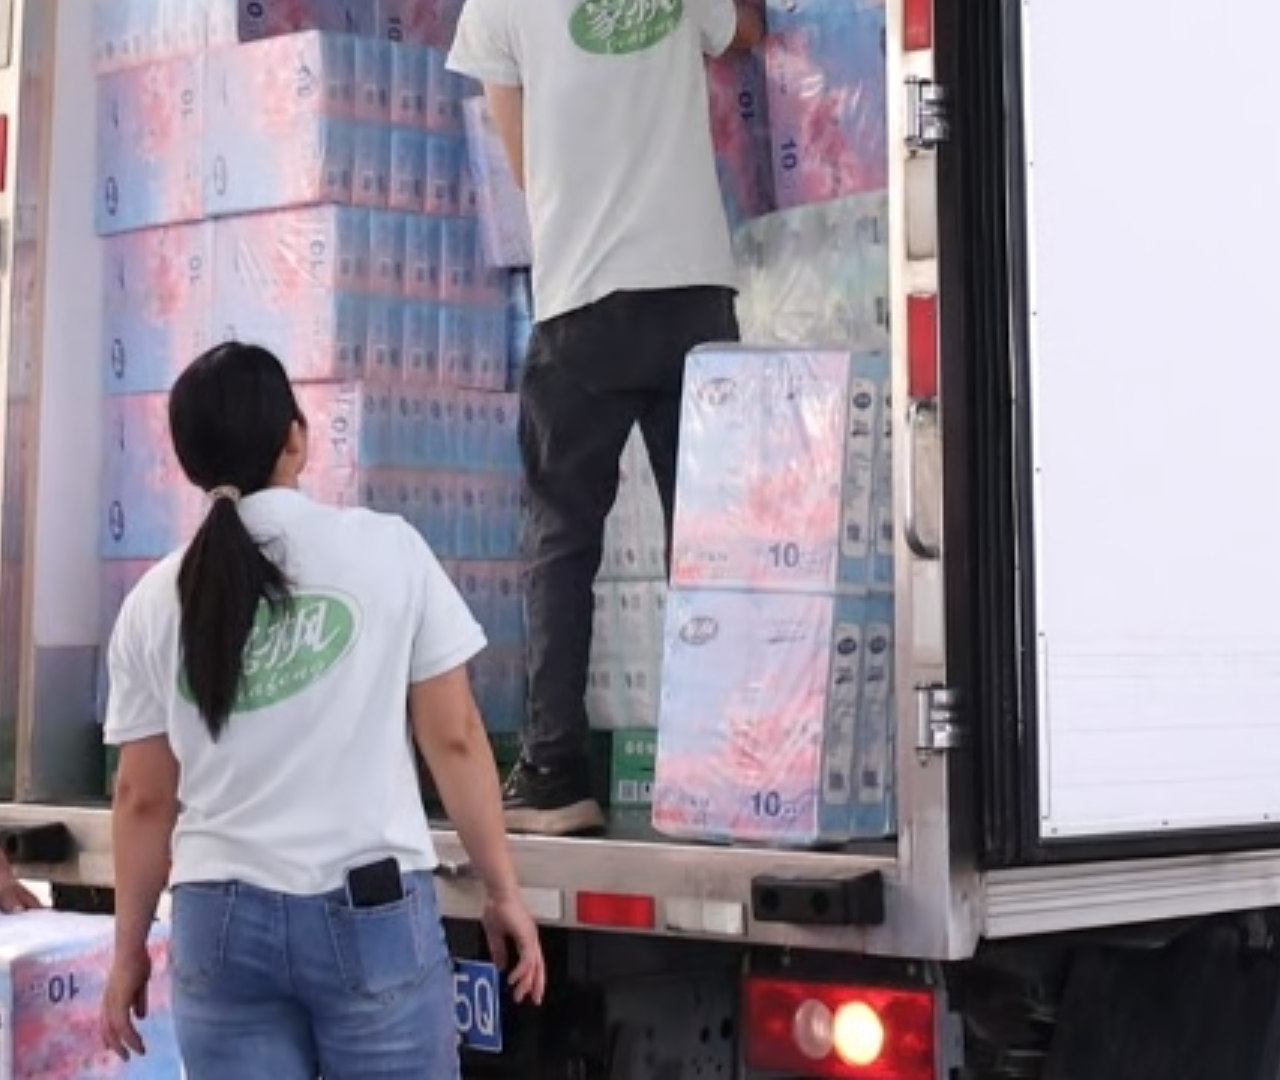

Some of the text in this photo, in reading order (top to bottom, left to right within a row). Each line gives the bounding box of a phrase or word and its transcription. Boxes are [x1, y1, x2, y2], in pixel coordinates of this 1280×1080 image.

[738, 91, 755, 120] 10
[781, 137, 797, 170] 10
[331, 416, 349, 447] 10
[767, 541, 800, 569] 10
[750, 790, 781, 818] 10
[47, 972, 81, 1005] 10
[453, 973, 494, 1035] 5Q
